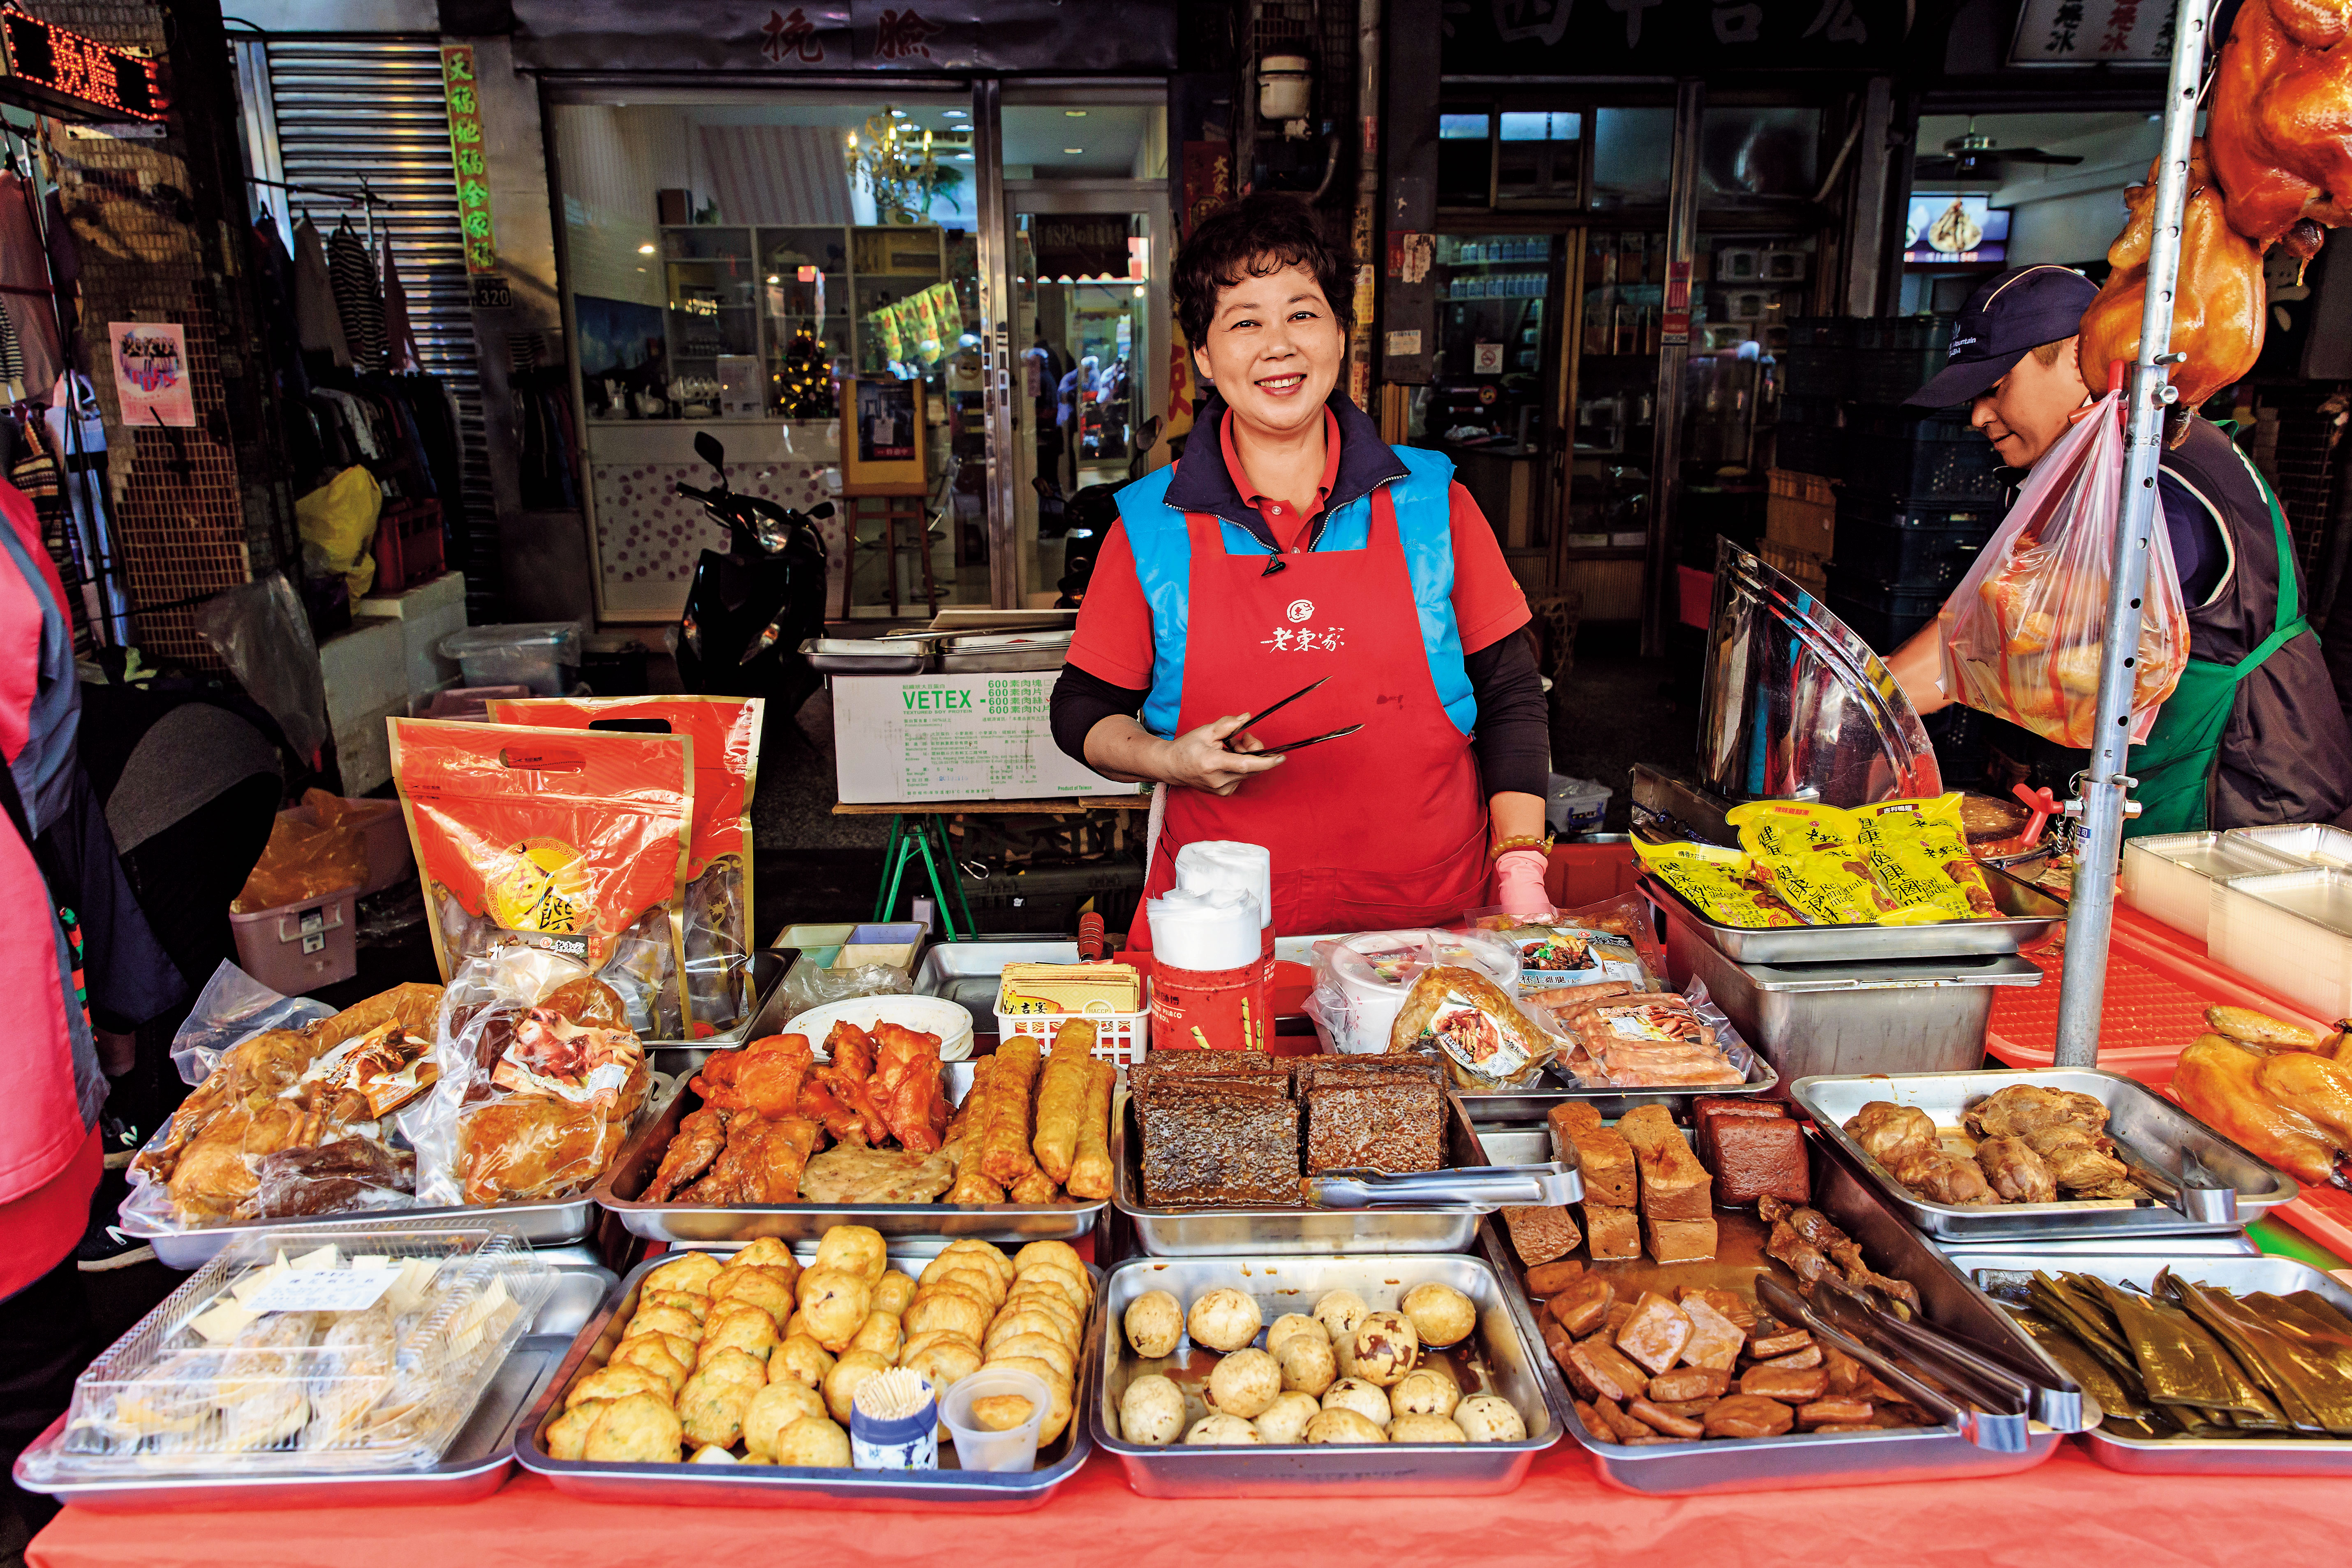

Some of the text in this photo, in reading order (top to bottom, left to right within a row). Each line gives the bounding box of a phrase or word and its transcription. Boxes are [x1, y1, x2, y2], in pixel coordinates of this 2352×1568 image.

[762, 8, 943, 63] 挽臉
[480, 289, 509, 305] 320
[1260, 627, 1345, 653] 老東家
[902, 690, 972, 709] VETEX
[1774, 806, 1810, 816] 辣味雞腳凍
[1883, 805, 1913, 814] 吉利鴨翅
[1923, 844, 1967, 859] 老東家
